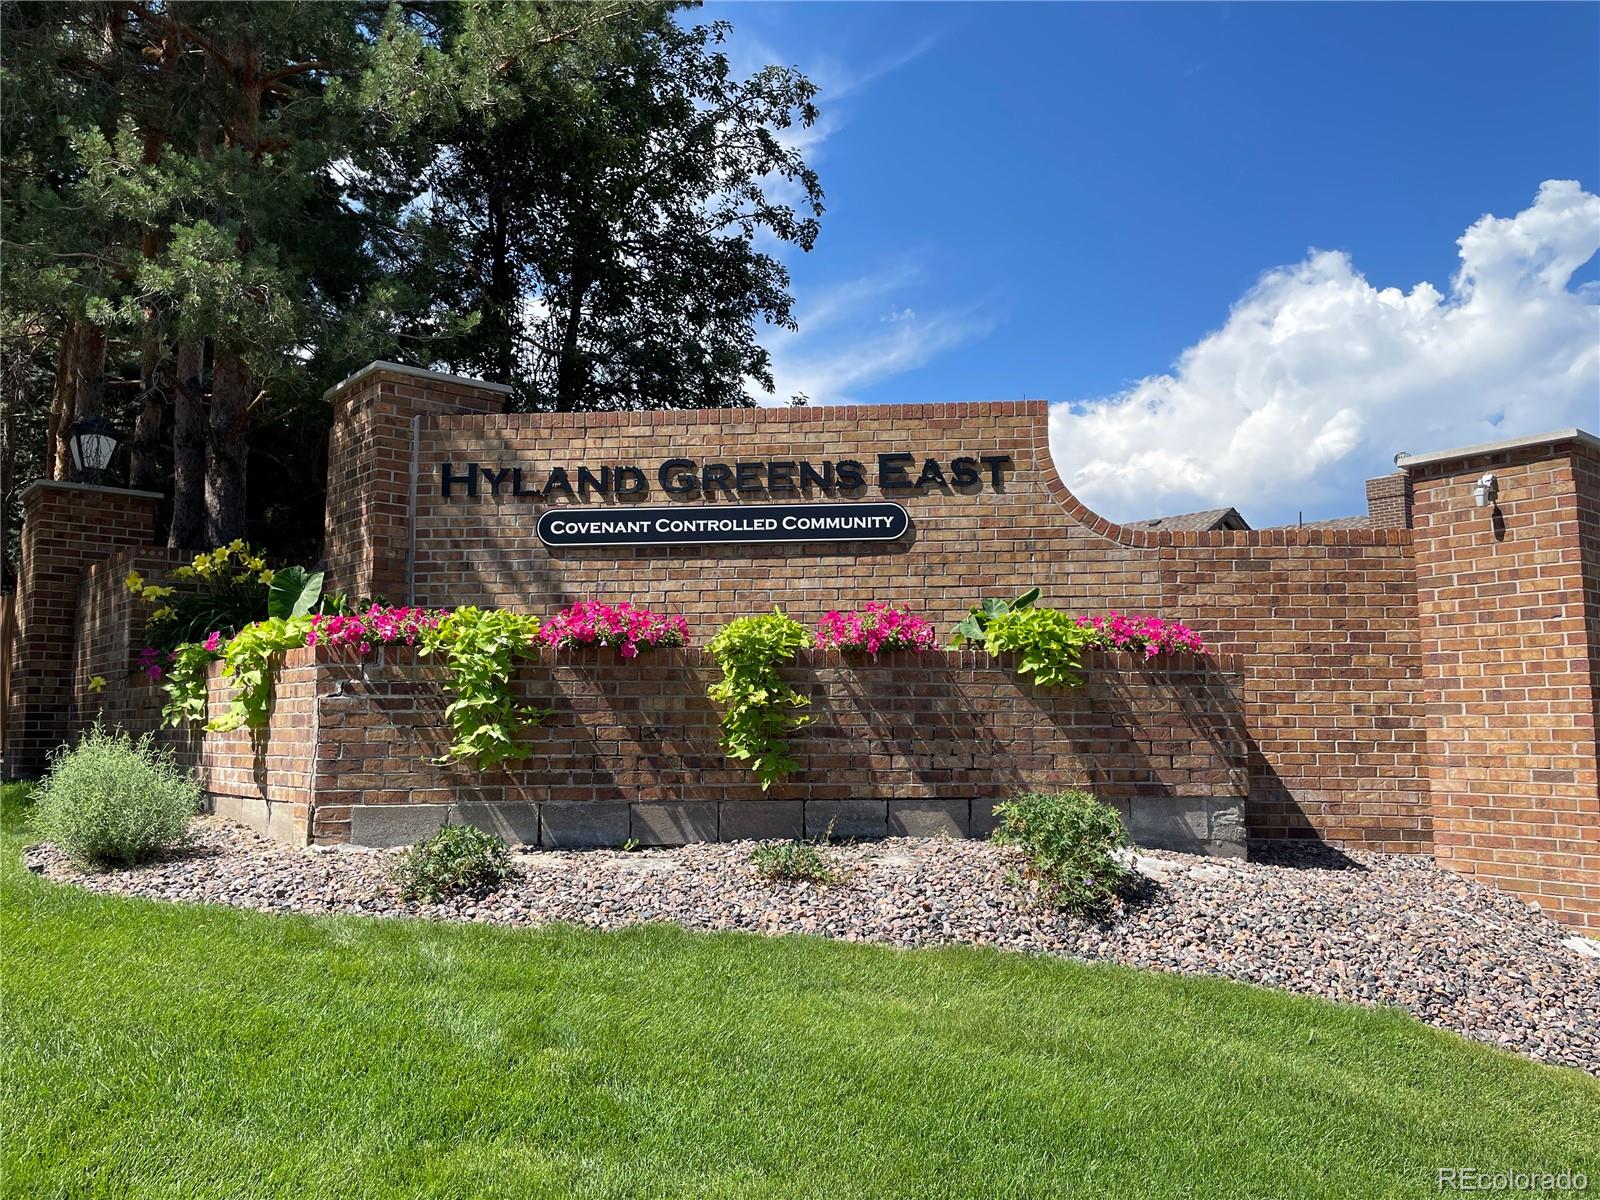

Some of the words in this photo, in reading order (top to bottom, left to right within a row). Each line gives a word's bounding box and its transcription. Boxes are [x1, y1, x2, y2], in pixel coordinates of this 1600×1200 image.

[441, 462, 647, 497] HYLAND
[657, 458, 866, 494] GREENS
[876, 452, 1012, 489] EAST
[550, 520, 652, 535] COVENANT
[655, 518, 778, 533] CONTROLLED
[782, 516, 895, 530] COMMUNITY
